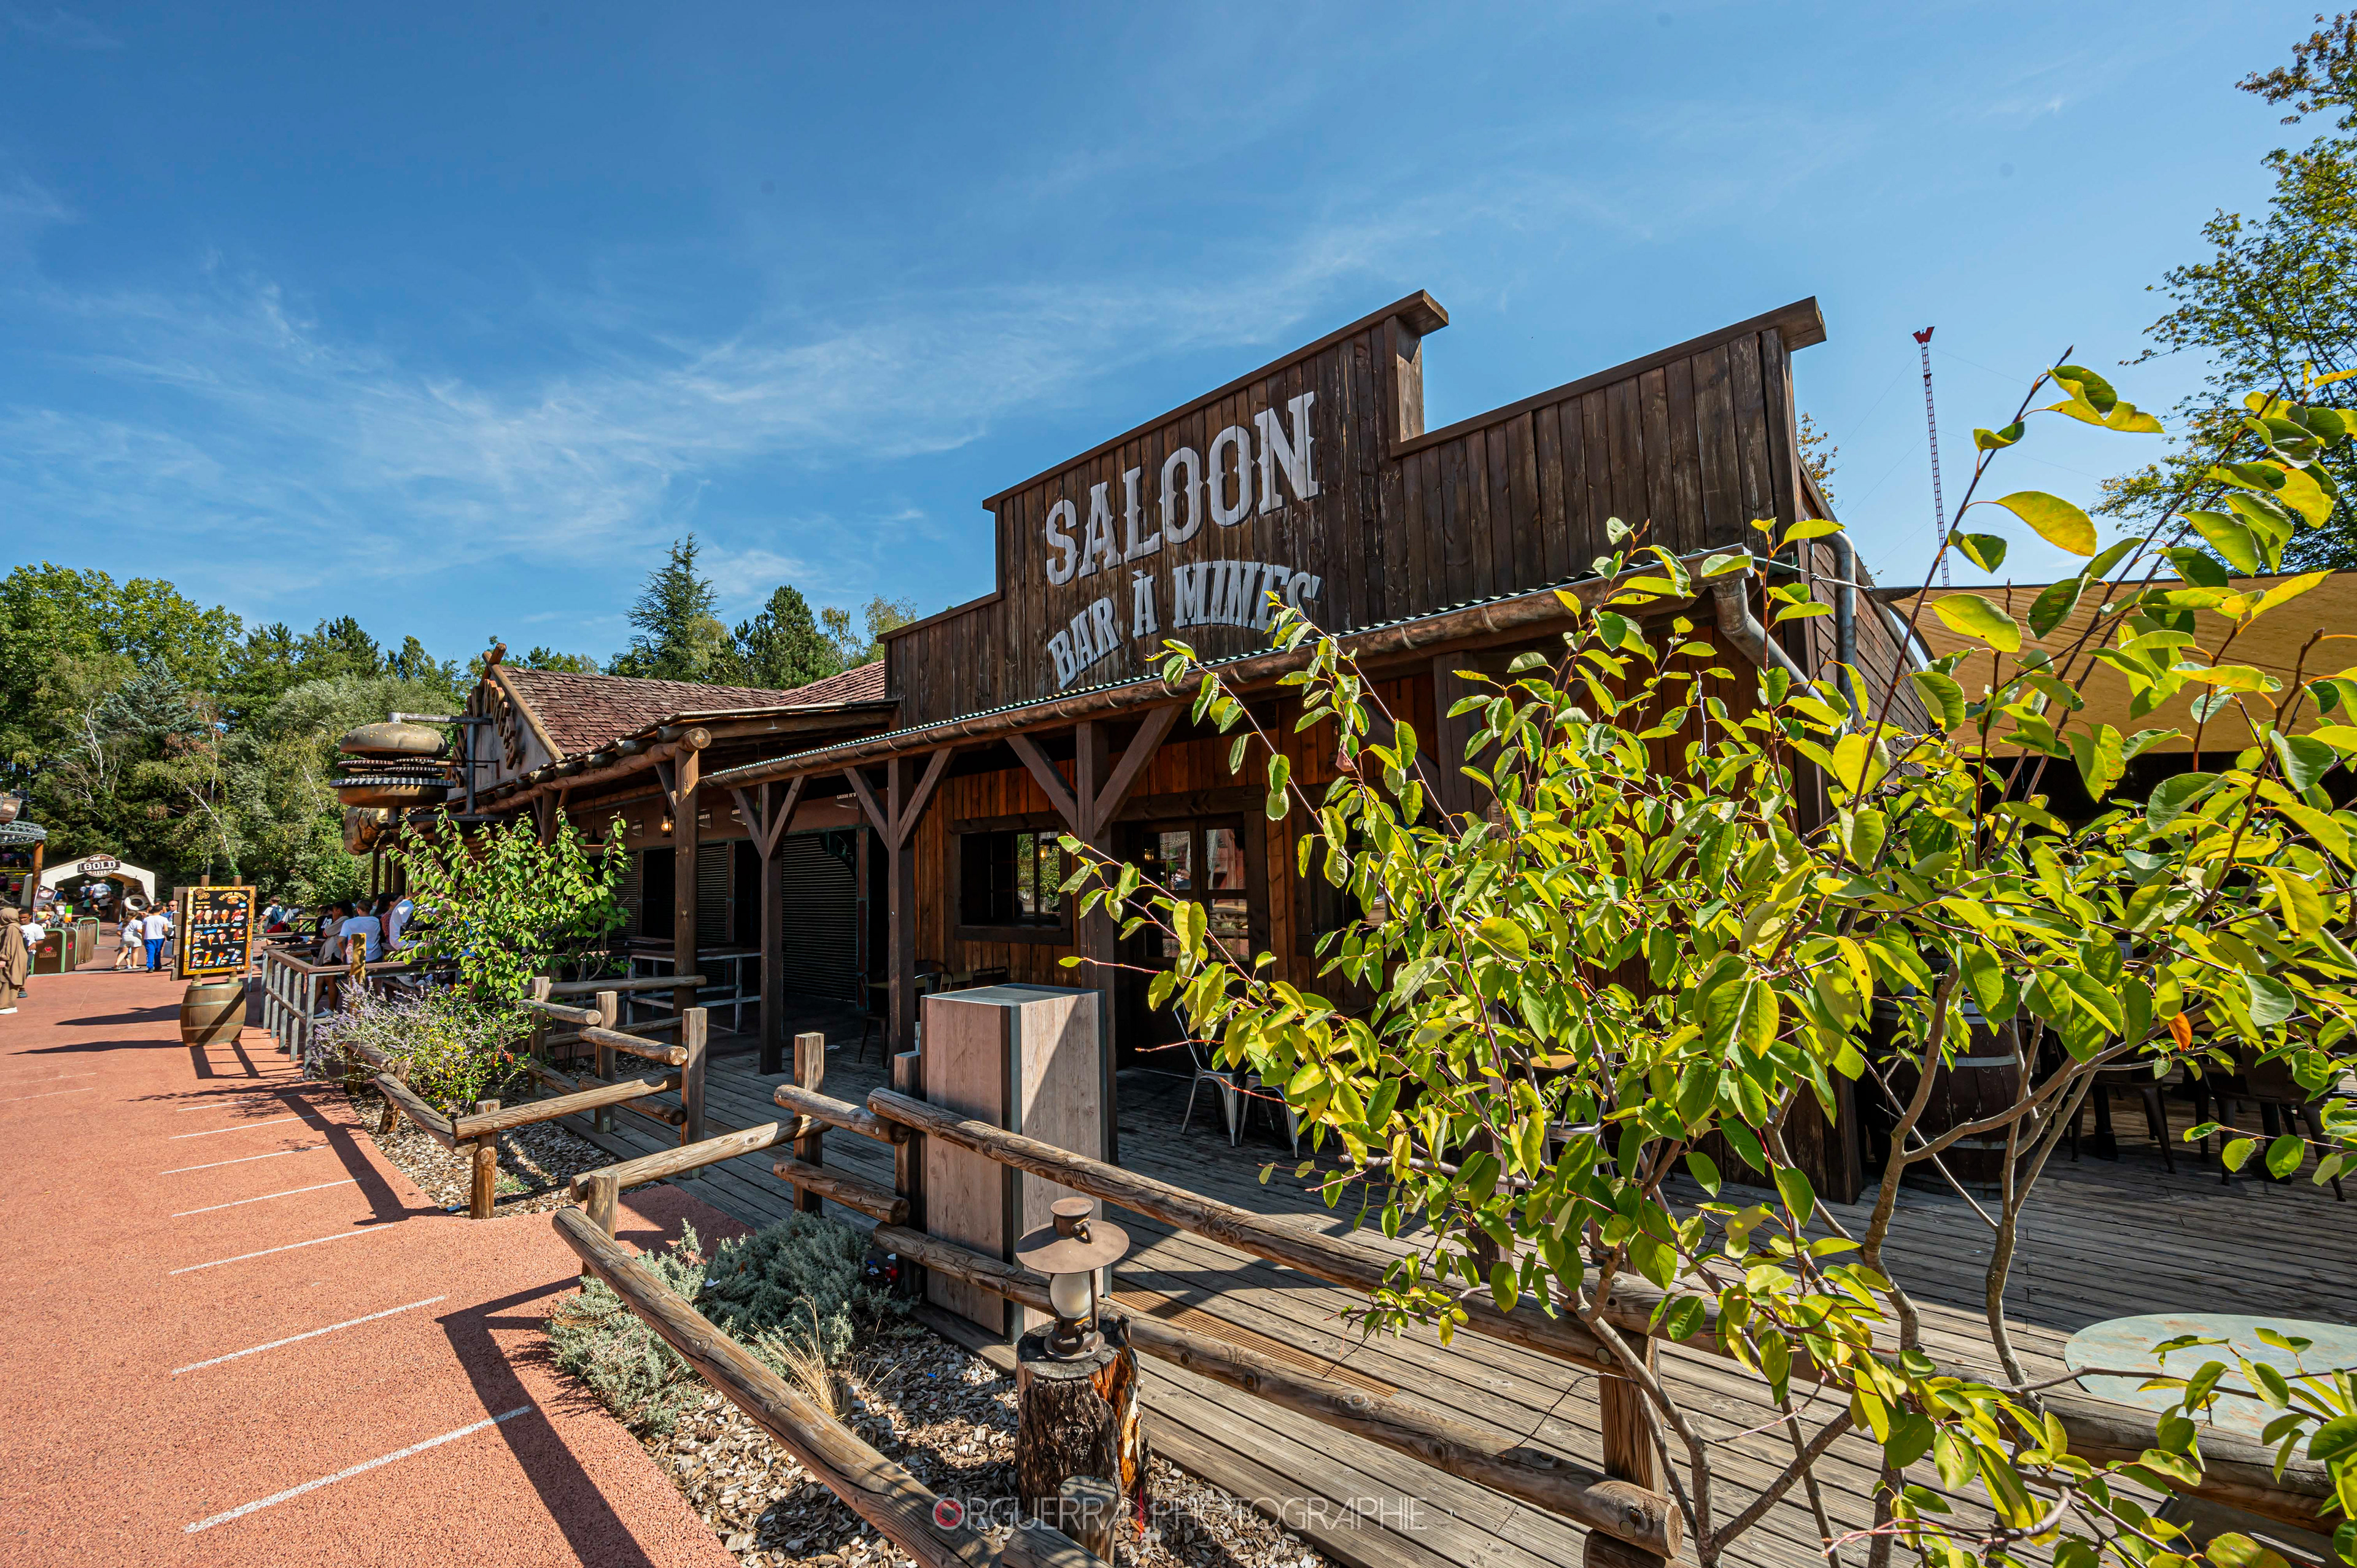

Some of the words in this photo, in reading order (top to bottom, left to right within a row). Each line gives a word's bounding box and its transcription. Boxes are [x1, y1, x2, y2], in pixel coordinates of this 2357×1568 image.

[1045, 390, 1320, 585] SALOON
[1047, 597, 1123, 691] BAR
[1132, 569, 1159, 639] À
[1172, 559, 1323, 635] MINES
[83, 860, 116, 870] GOLD
